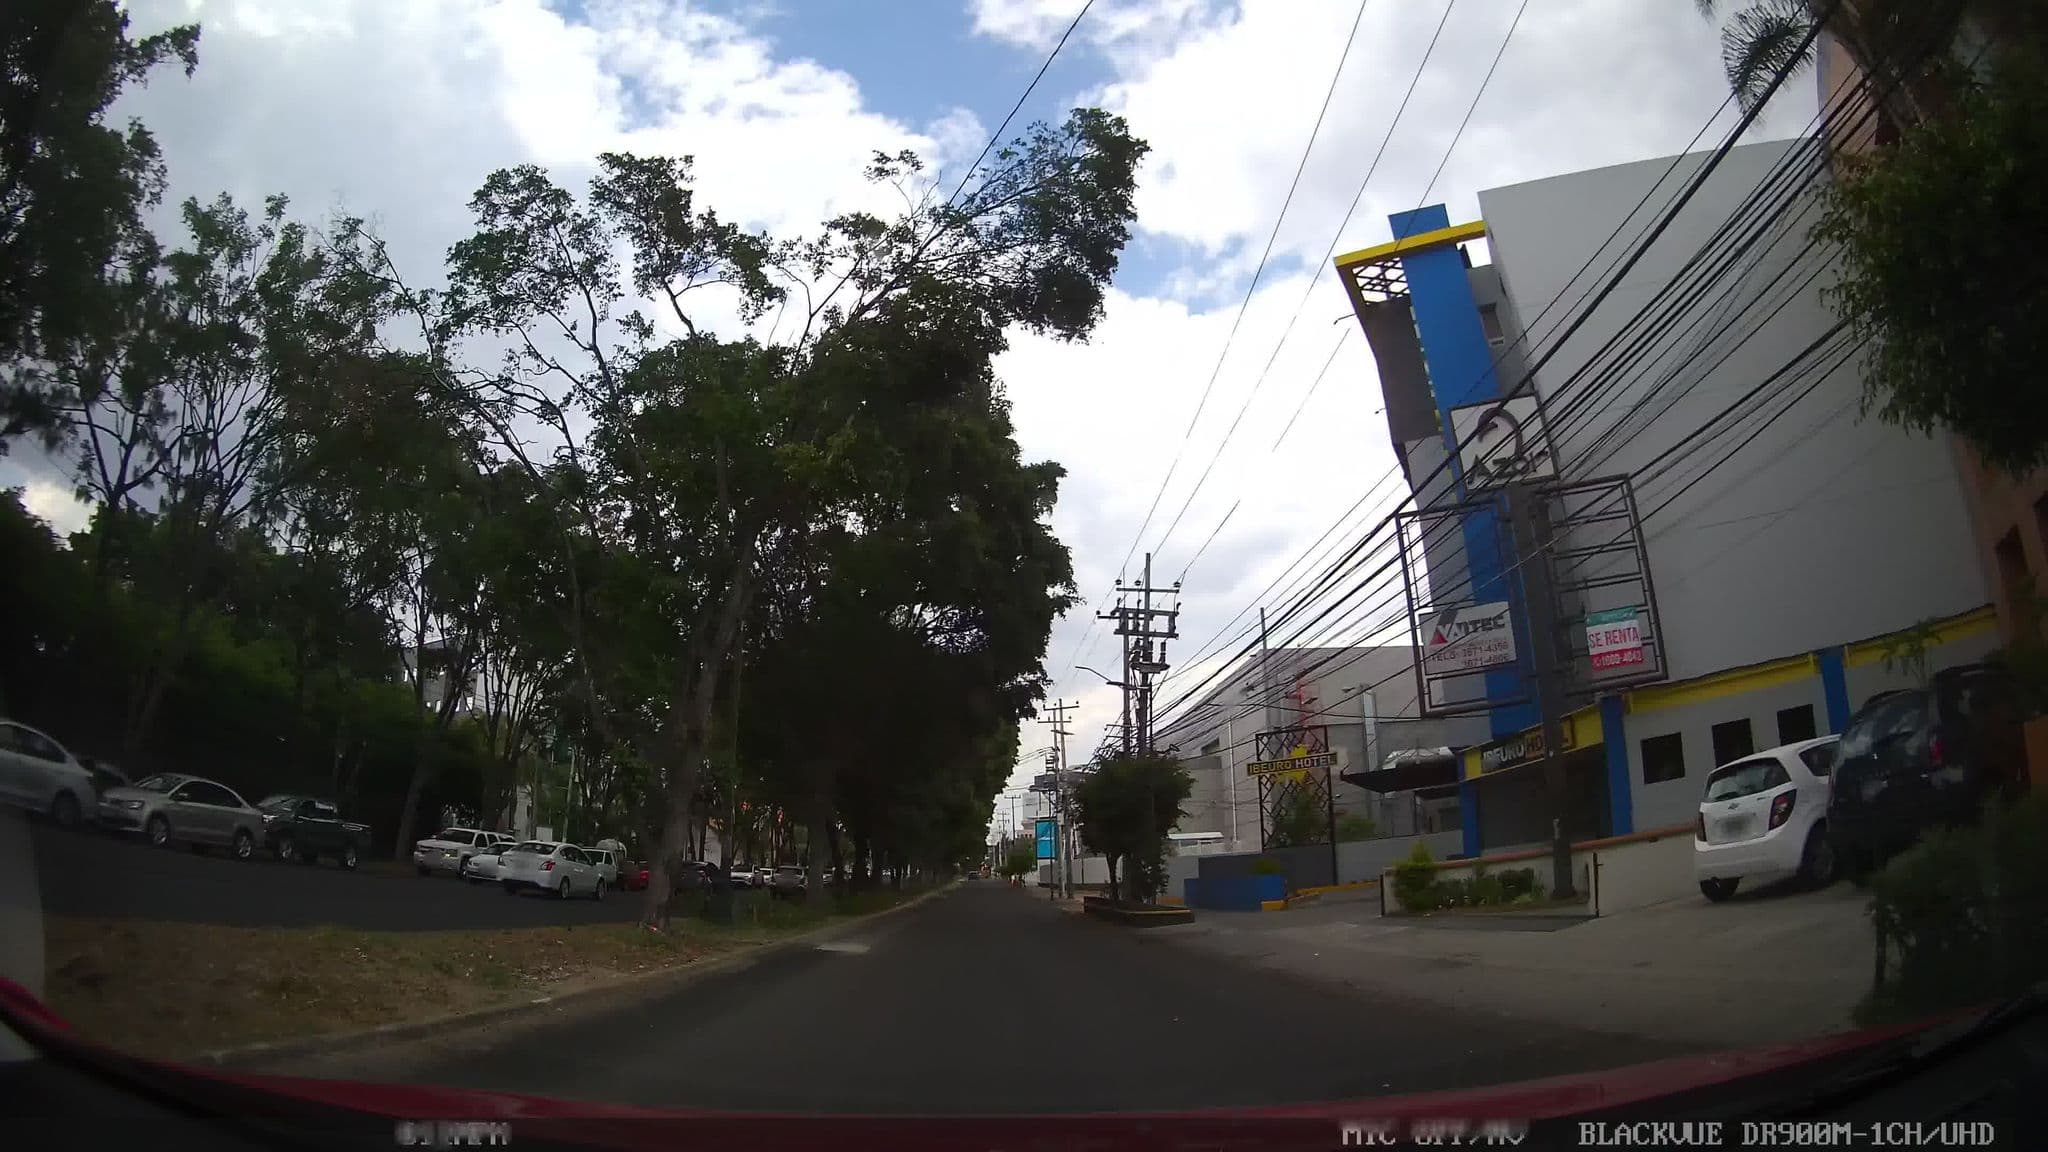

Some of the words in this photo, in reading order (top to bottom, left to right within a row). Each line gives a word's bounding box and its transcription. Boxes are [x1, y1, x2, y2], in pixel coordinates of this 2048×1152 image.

[1589, 632, 1603, 648] SE
[1605, 627, 1640, 645] RENTA
[1296, 755, 1335, 768] HOTEL
